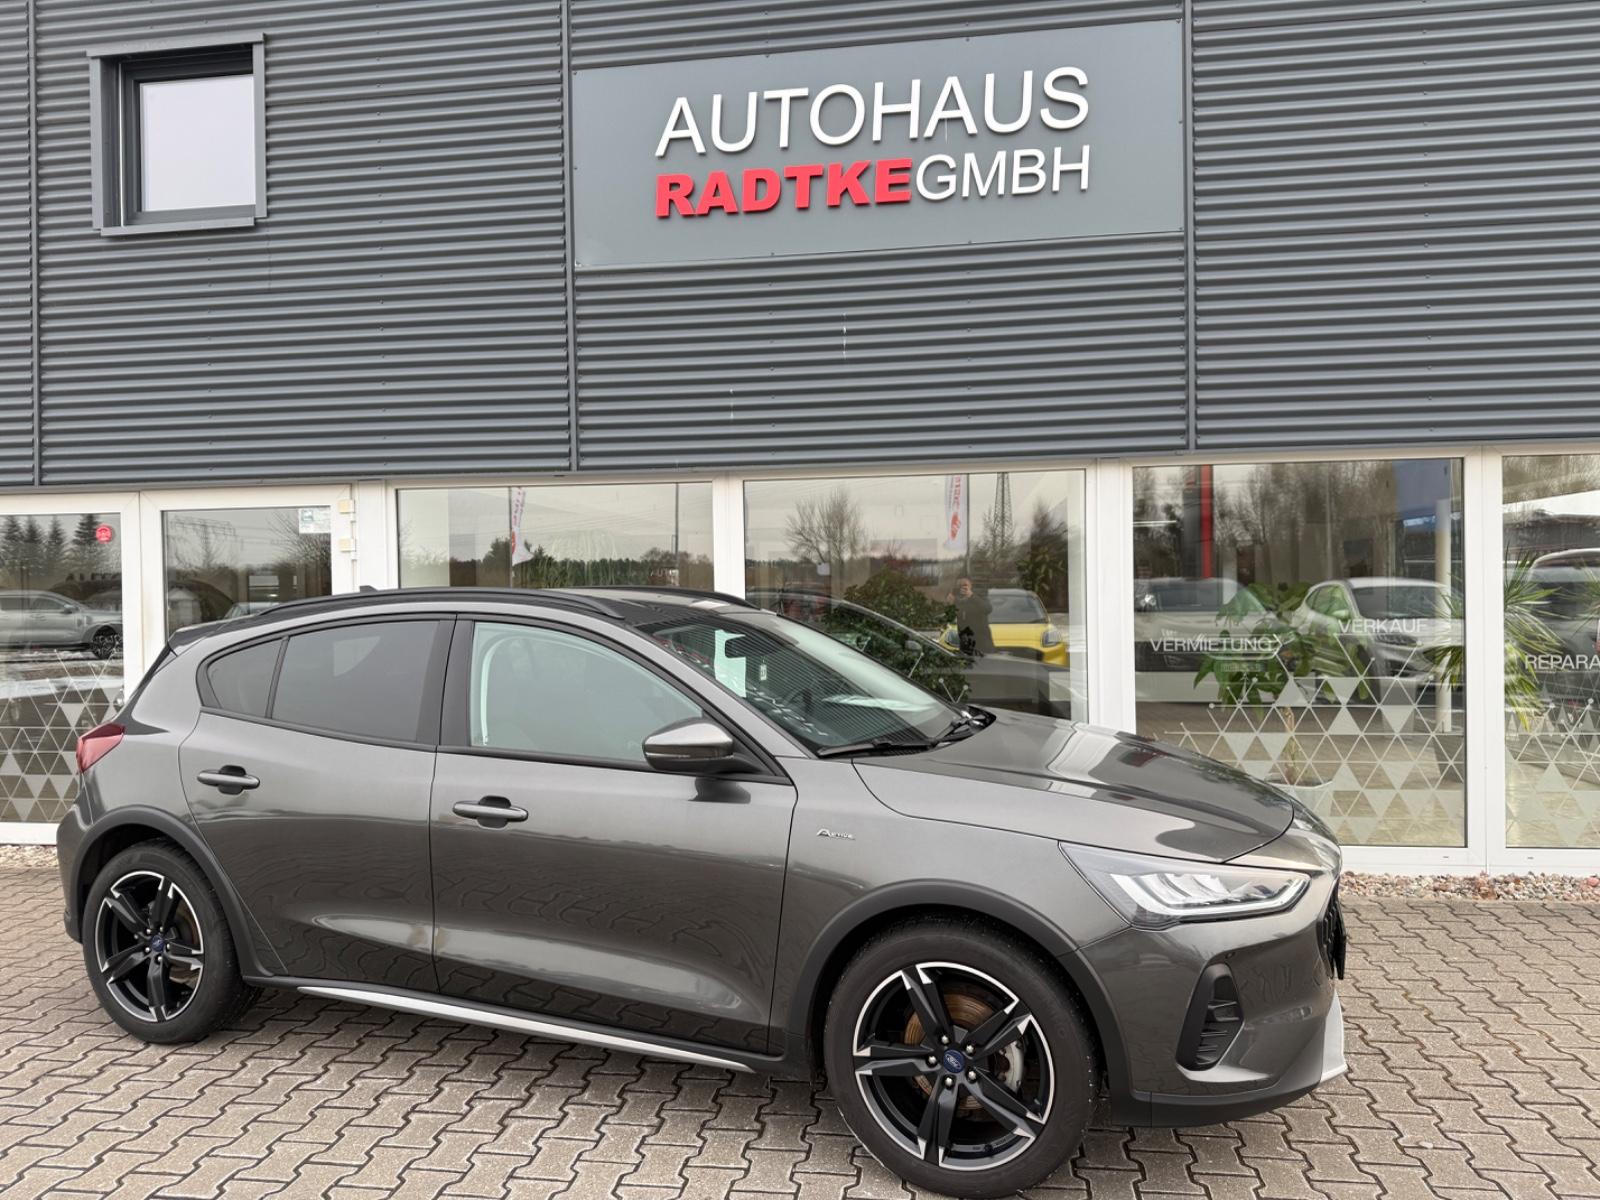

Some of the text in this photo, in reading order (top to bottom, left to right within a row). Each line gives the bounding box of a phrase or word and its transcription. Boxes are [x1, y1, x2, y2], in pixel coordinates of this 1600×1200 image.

[654, 66, 1090, 158] AUTOHAUS
[654, 145, 1092, 219] RADTKE GMBH
[1337, 618, 1429, 634] VERKAUF
[1149, 637, 1275, 653] VERMIETUNG
[1524, 653, 1600, 670] REPARA
